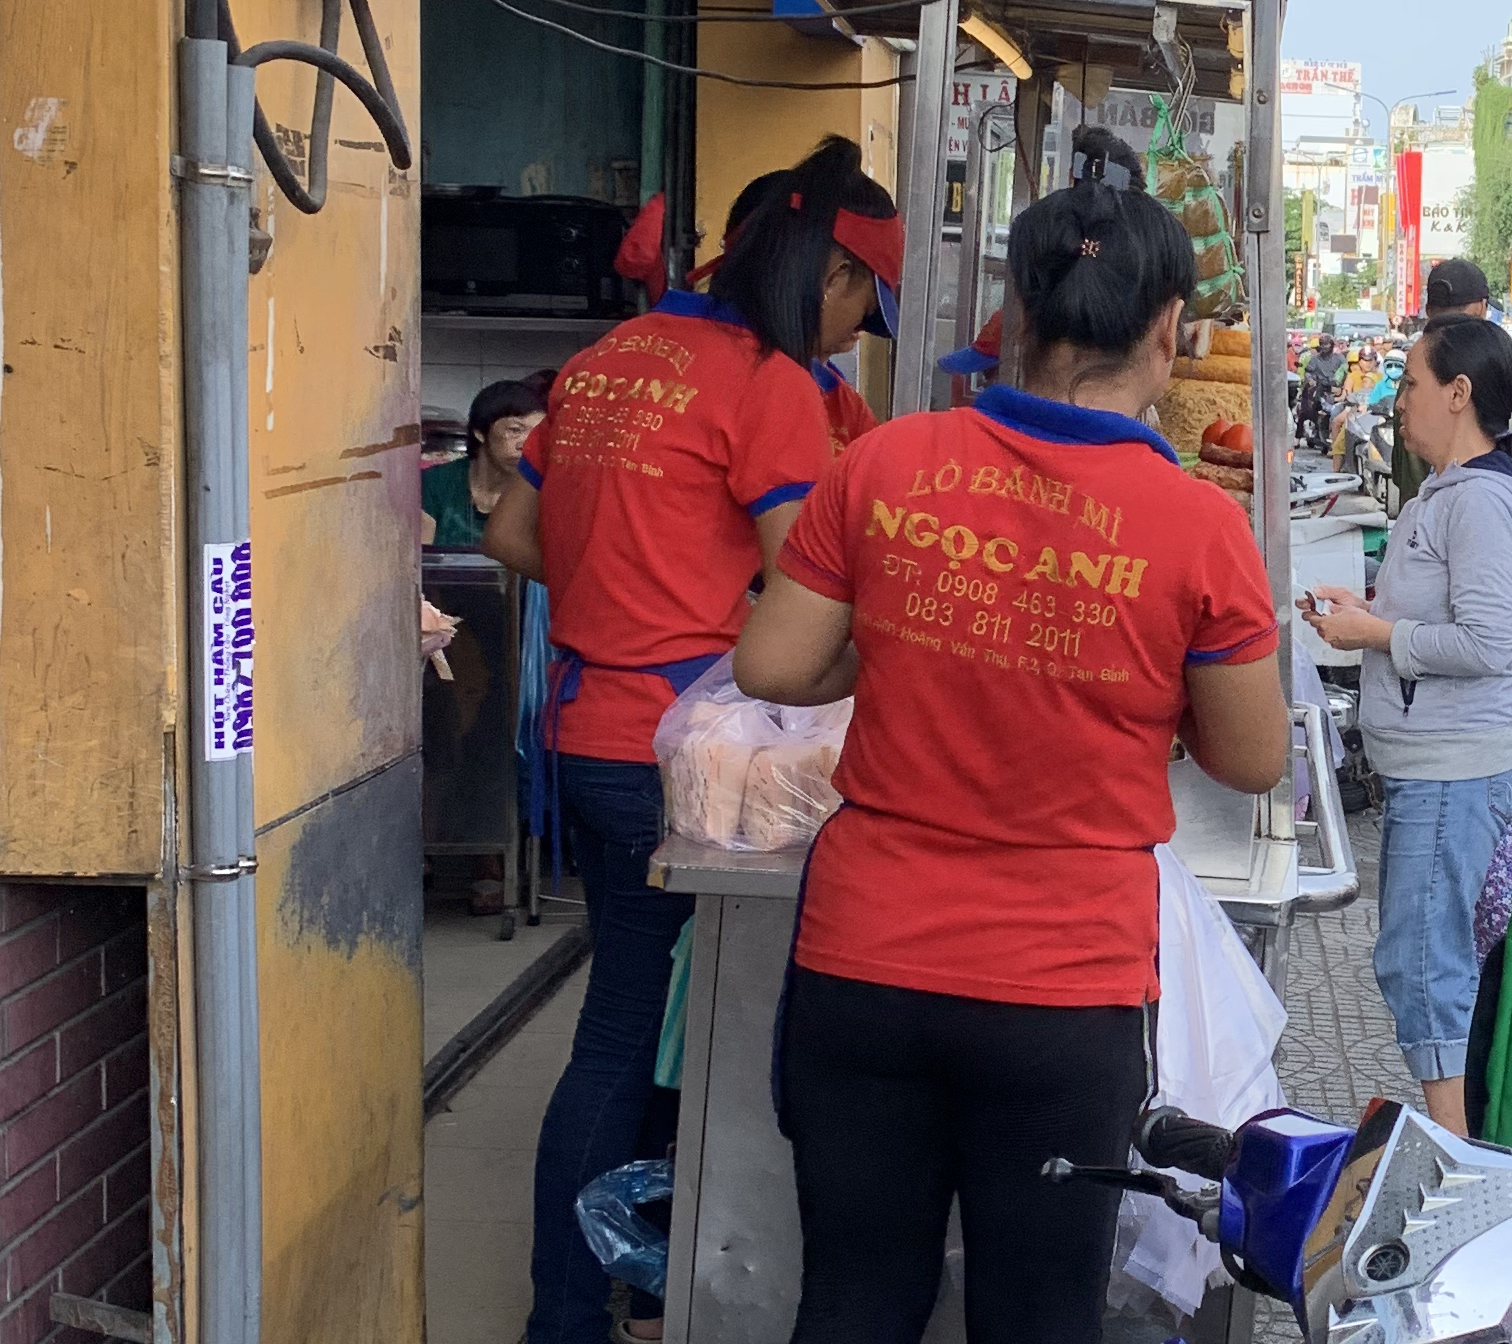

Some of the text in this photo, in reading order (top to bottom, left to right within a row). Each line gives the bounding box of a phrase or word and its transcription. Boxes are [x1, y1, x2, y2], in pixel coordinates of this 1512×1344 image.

[907, 458, 962, 499] LÒ
[865, 499, 1149, 599] NGỌC ANH
[904, 592, 955, 627] 083
[970, 610, 1013, 645] 811
[1025, 623, 1082, 659] 2011
[936, 571, 999, 605] 0908
[1012, 589, 1057, 619] 463
[1071, 600, 1117, 628] 330
